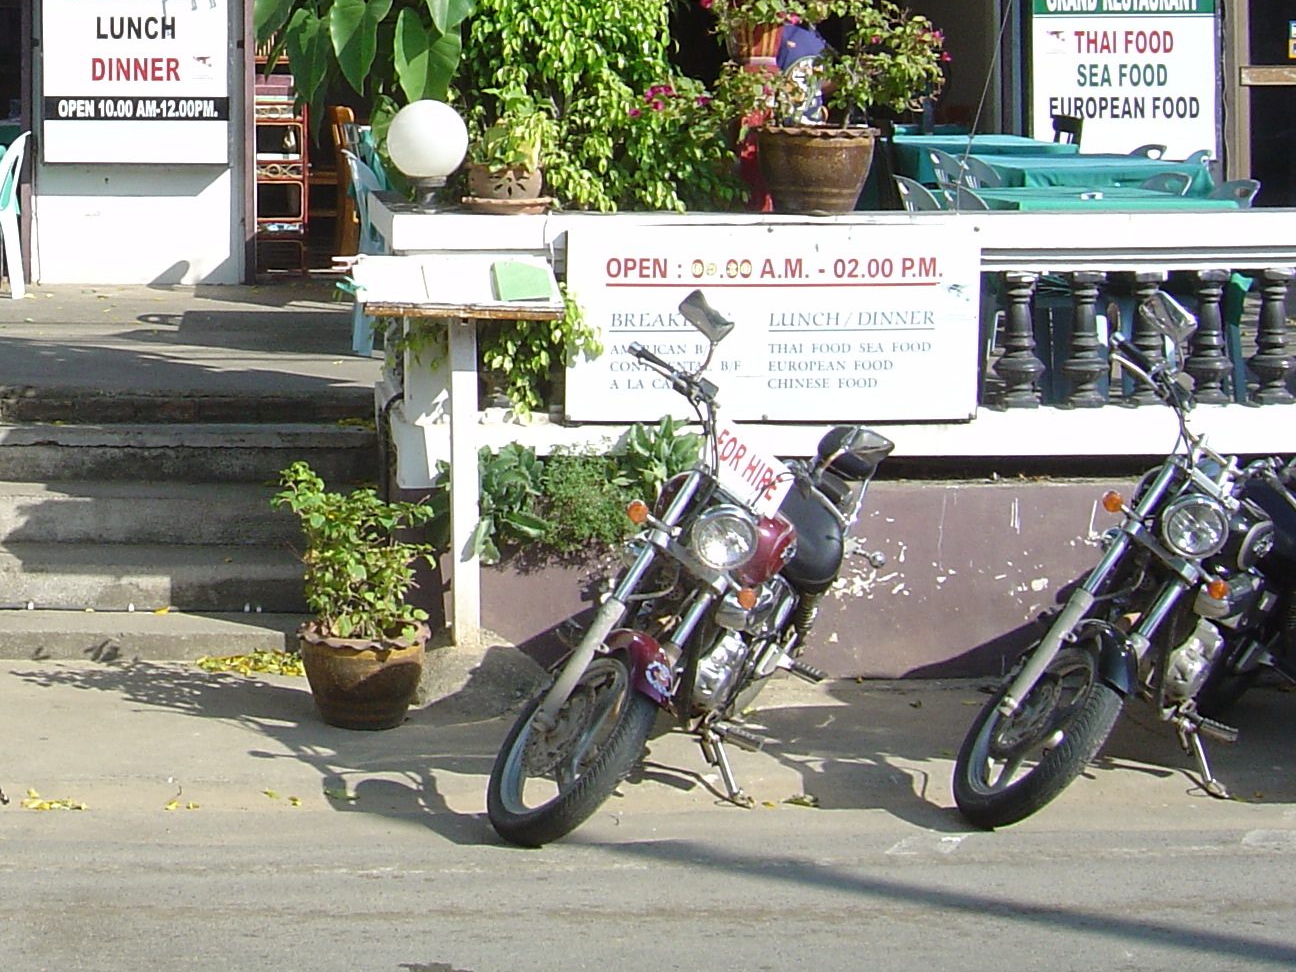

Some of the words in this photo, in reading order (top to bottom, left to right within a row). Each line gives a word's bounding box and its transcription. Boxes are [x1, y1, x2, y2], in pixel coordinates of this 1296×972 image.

[96, 16, 176, 39] LUNCH
[1074, 30, 1117, 54] THAI
[1124, 30, 1174, 54] FOOD
[91, 58, 181, 81] DINNER
[1077, 64, 1112, 87] SEA
[1118, 64, 1168, 87] FOOD
[58, 100, 95, 118] OPEN
[98, 100, 133, 117] 10.00
[1049, 96, 1145, 119] EUROPEAN
[1152, 96, 1200, 119] FOOD
[606, 258, 667, 278] OPEN
[760, 258, 810, 278] A.M.
[833, 258, 893, 278] 02.00
[901, 257, 944, 278] P.M.
[611, 313, 731, 327] BREAK
[769, 312, 840, 327] LUNCH
[857, 311, 935, 326] DINNER
[768, 343, 803, 354] THAI
[812, 343, 851, 354] FOOD
[859, 342, 884, 353] SEA
[892, 342, 932, 353] FOOD
[768, 361, 846, 371] EUROPEAN
[854, 360, 894, 371] FOOD
[610, 379, 619, 389] A
[627, 379, 645, 389] LA
[767, 378, 830, 389] CHINESE
[838, 378, 878, 388] FOOD
[717, 429, 747, 471] FOR
[741, 455, 784, 501] HIRE
